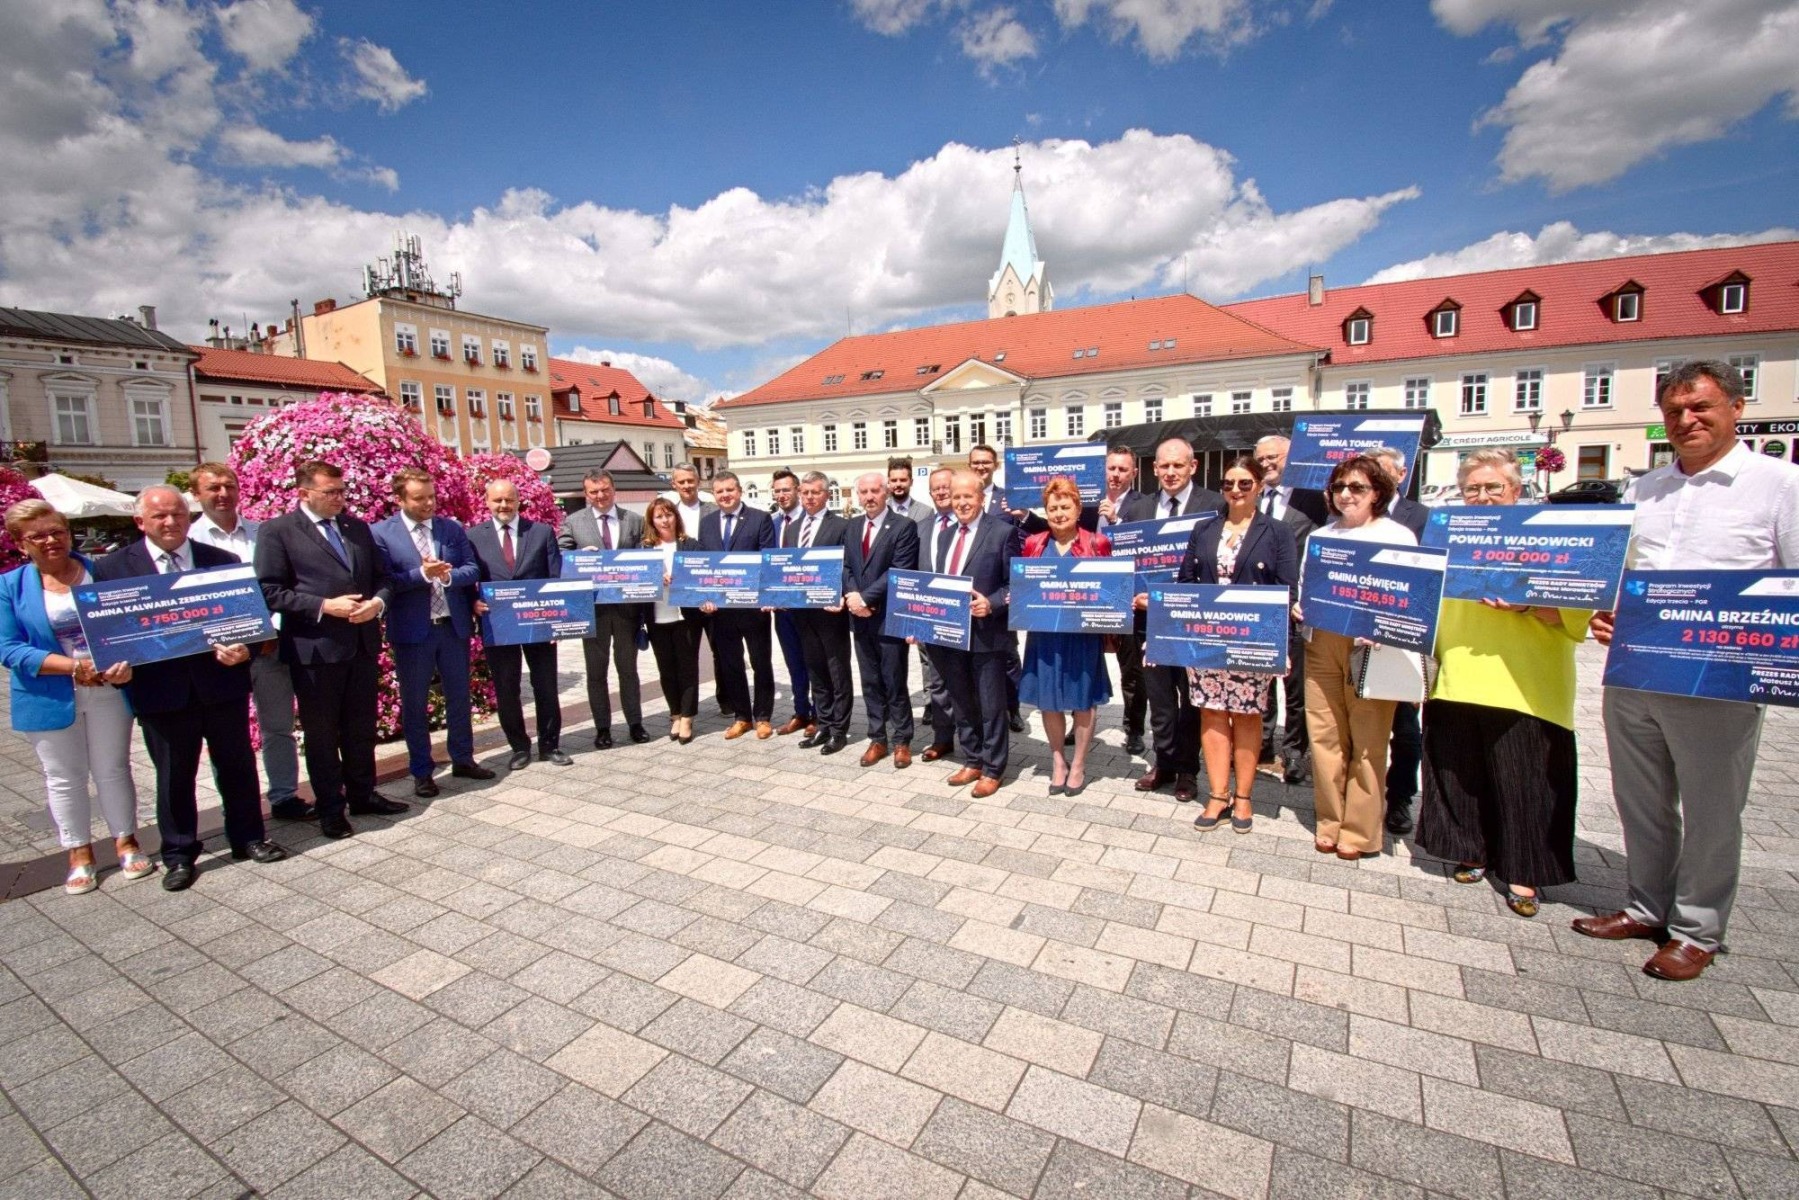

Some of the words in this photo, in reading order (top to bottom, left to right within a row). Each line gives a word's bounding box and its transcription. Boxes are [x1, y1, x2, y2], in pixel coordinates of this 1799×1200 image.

[1770, 423, 1799, 432] EKO
[1350, 439, 1384, 448] TOMICE
[1453, 436, 1485, 444] CRÉDIT
[1487, 435, 1531, 443] AGRICOLE
[1023, 465, 1047, 473] GMINA
[1048, 464, 1086, 472] DOBCZYCE
[1449, 534, 1503, 545] POWIAT
[1504, 536, 1595, 547] WADOWICKI
[1111, 547, 1137, 557] GMINA
[1138, 543, 1175, 555] POLANKA
[1472, 550, 1481, 560] 2
[1485, 550, 1515, 561] 000
[1519, 551, 1550, 562] 000
[1554, 553, 1570, 564] zł
[1039, 581, 1069, 589] GMINA
[1070, 581, 1101, 589] WIEPRZ
[1328, 571, 1358, 584] GMINA
[1359, 574, 1409, 593] OŚWIĘCIM
[1339, 587, 1357, 598] 953
[87, 606, 124, 619] GMINA
[124, 599, 178, 614] KALWARIA
[178, 586, 255, 605] ZEBRZYDOWSKA
[512, 600, 539, 609] GMINA
[540, 599, 565, 608] ZATOR
[140, 616, 150, 627] 2
[152, 611, 179, 624] 750
[182, 607, 209, 620] 000
[1170, 610, 1202, 620] GMINA
[1203, 611, 1260, 622] WADOWICE
[1659, 609, 1714, 622] GMINA
[1185, 623, 1190, 632] 1
[1216, 625, 1237, 635] 000
[1682, 629, 1693, 642] 2
[1698, 630, 1730, 645] 130
[1736, 632, 1775, 647] 660
[1780, 634, 1799, 649] zł
[1751, 669, 1779, 678] PREZES
